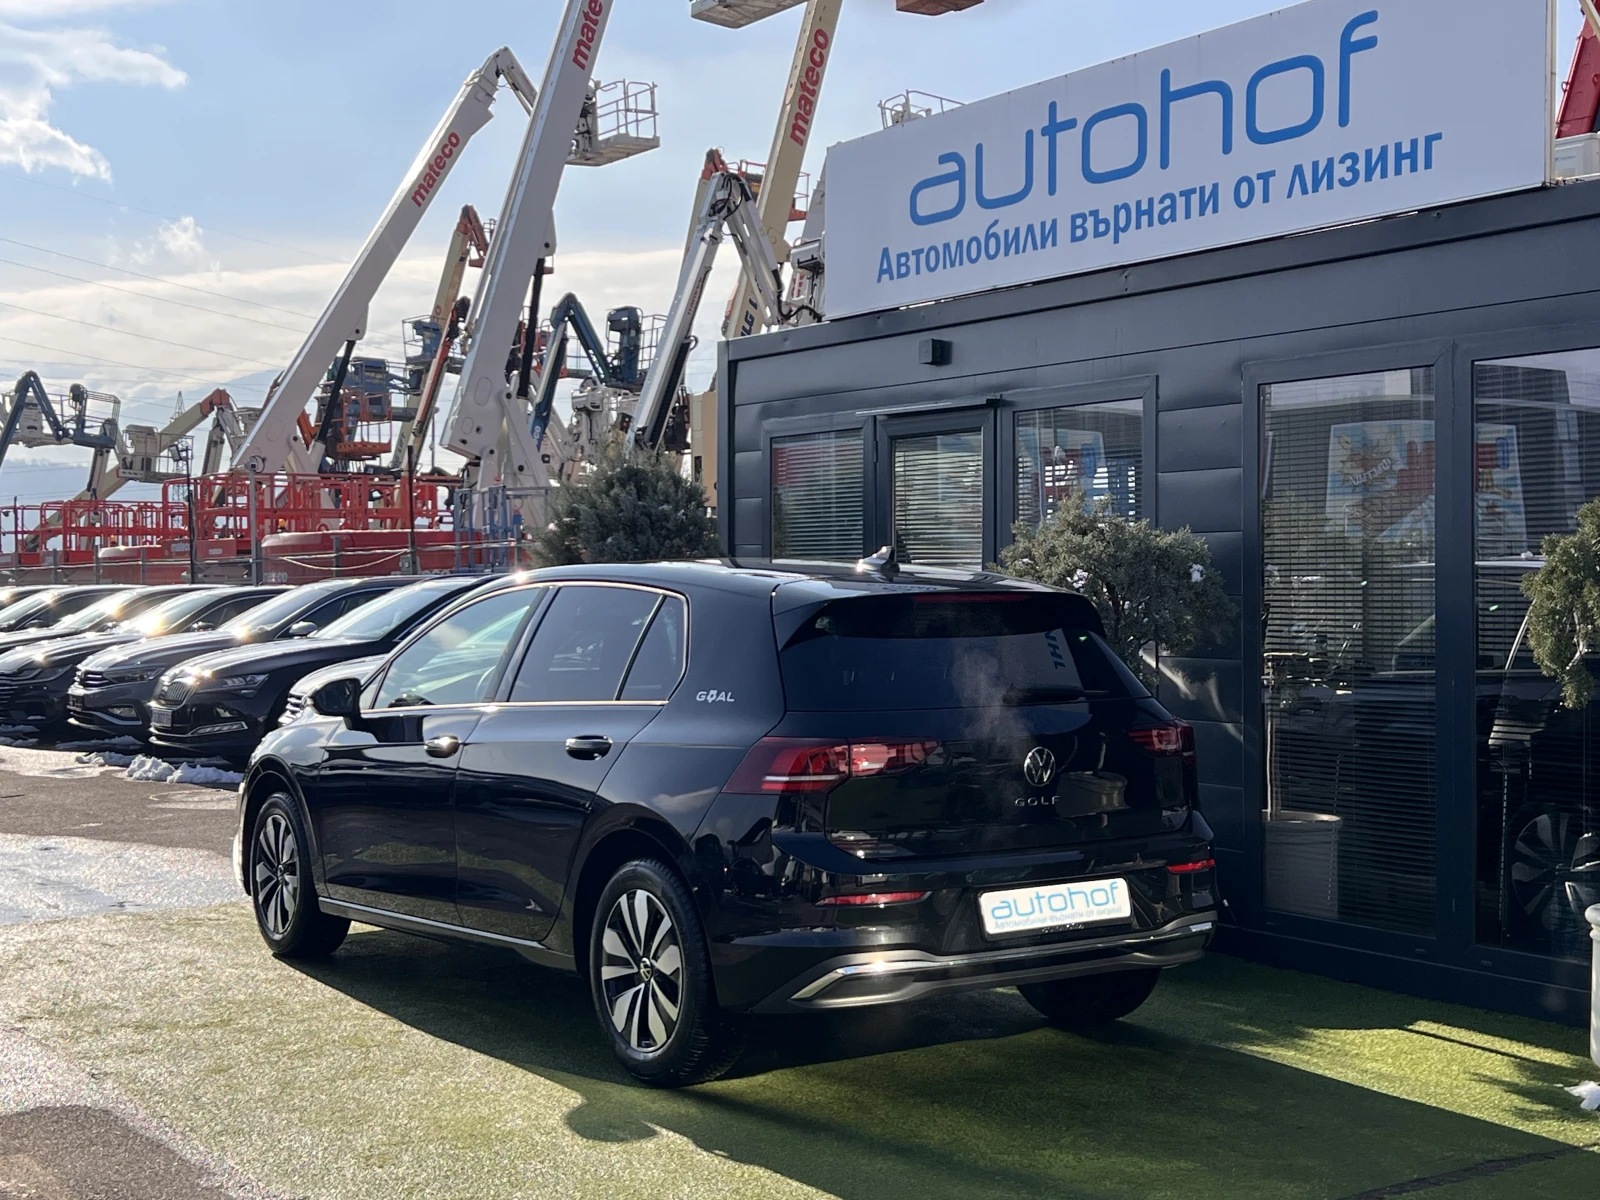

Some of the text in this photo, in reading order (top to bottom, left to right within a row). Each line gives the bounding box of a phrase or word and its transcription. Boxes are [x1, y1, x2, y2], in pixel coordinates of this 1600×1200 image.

[790, 28, 829, 147] mateco
[909, 9, 1379, 226] autohof
[411, 132, 460, 208] mateco
[876, 130, 1443, 284] Автомобили върнати от лизинг
[696, 689, 735, 703] GOAL
[1015, 796, 1060, 807] GOLF
[991, 881, 1119, 920] autohof
